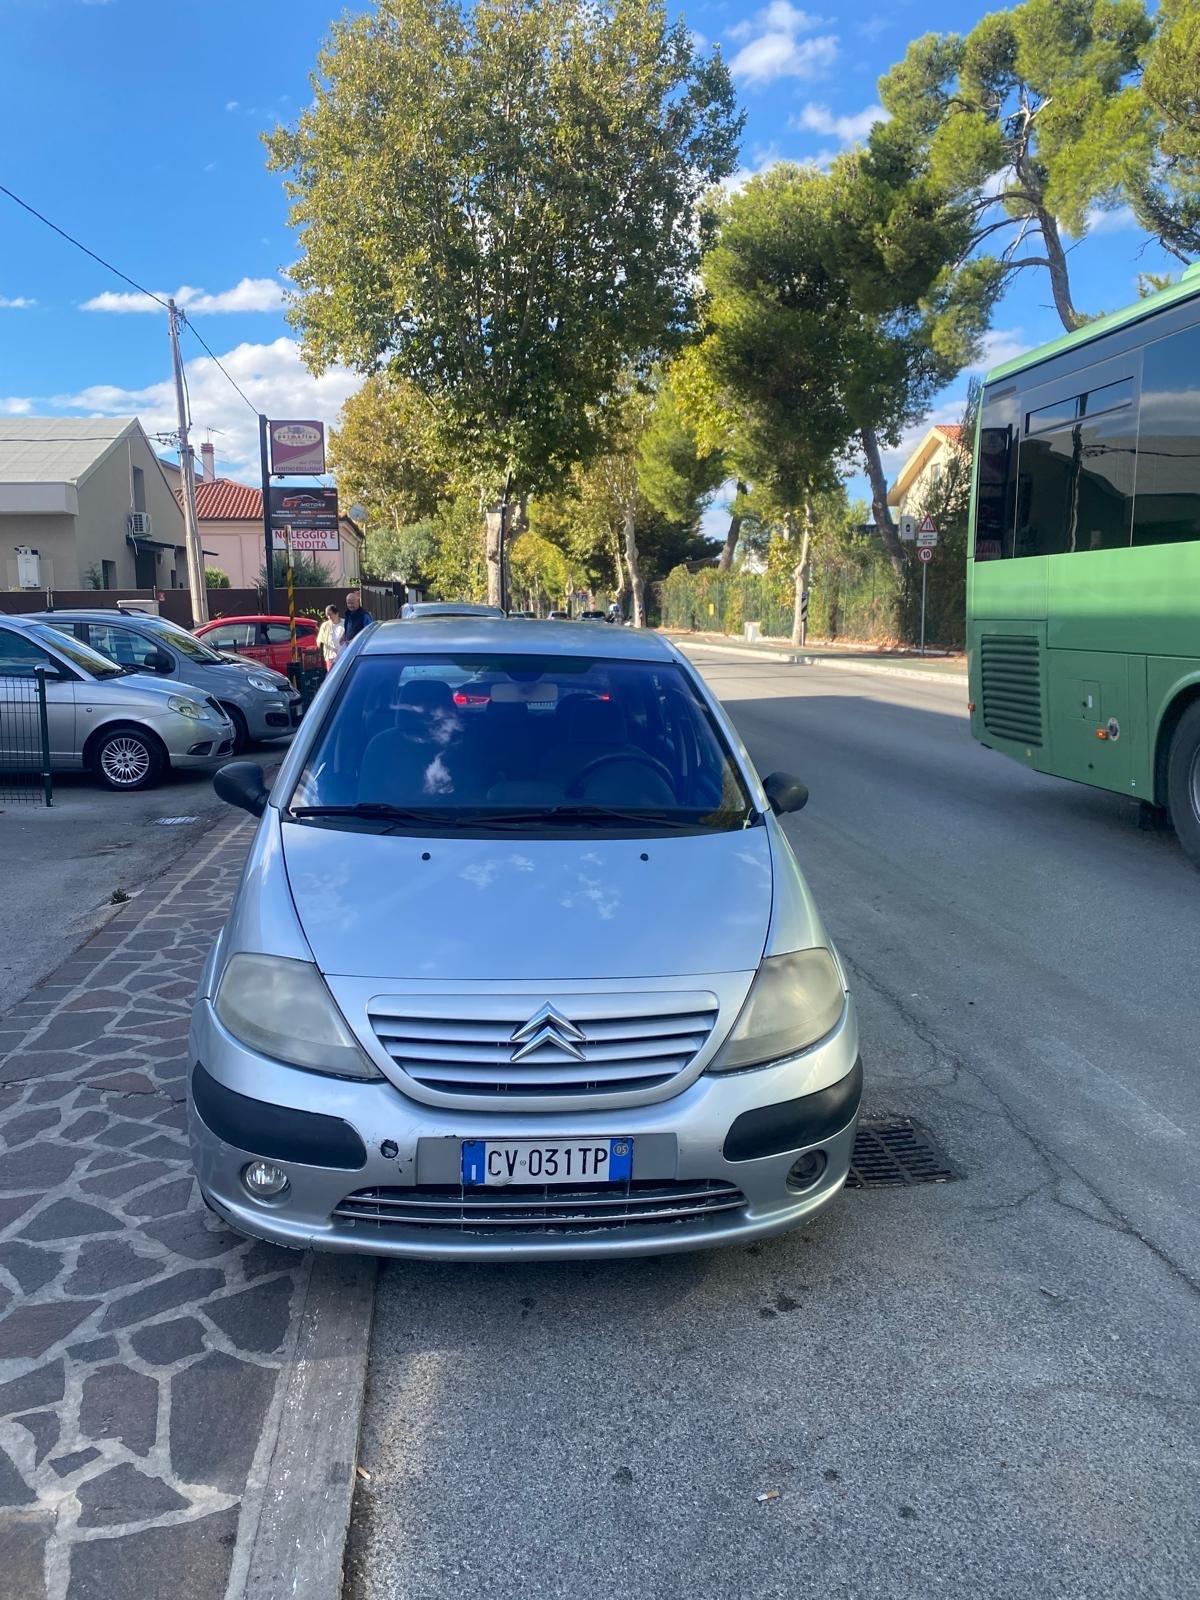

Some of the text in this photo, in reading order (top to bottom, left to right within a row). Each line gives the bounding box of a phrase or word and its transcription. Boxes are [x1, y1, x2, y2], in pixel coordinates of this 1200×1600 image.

[330, 531, 336, 539] E
[290, 540, 327, 549] ENDITA
[923, 550, 931, 559] 10
[488, 1147, 608, 1177] CV 031TP
